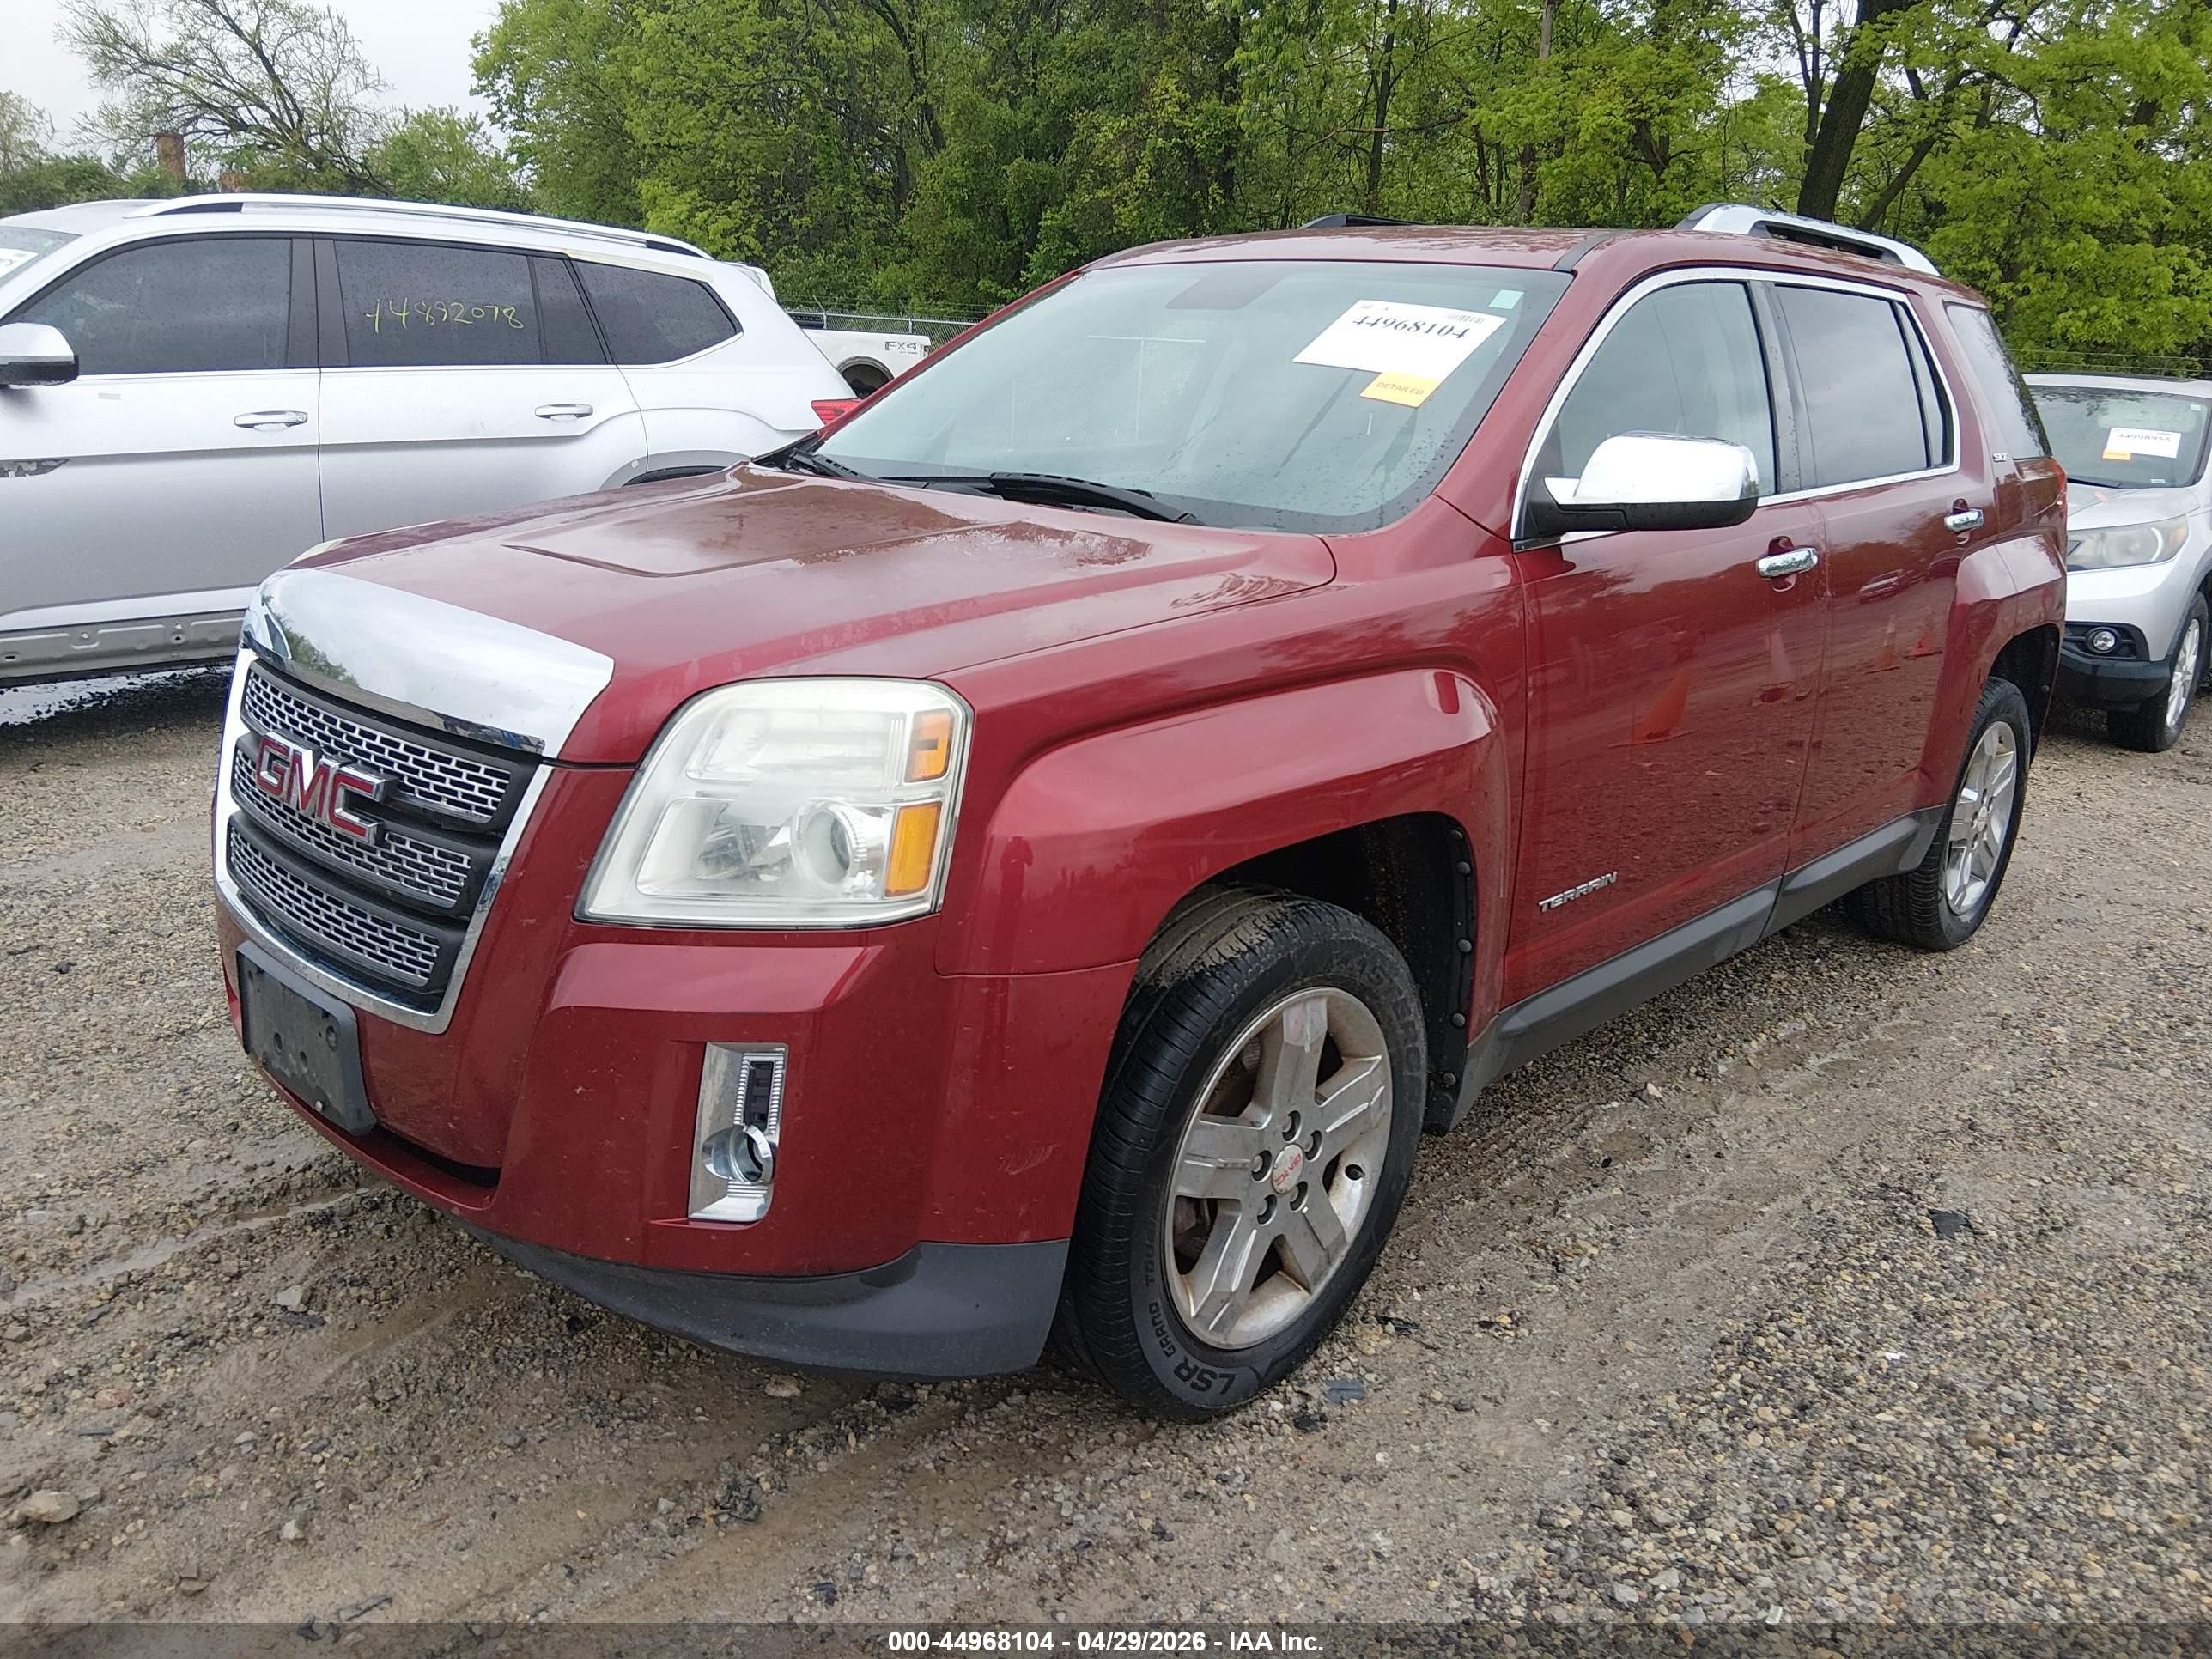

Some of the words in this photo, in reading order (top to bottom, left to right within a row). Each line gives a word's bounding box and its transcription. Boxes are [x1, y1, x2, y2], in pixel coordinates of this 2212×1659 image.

[884, 341, 917, 351] FX4
[1352, 315, 1471, 339] 44968104
[1376, 381, 1425, 395] DETAILED
[255, 732, 386, 845] GMC
[1538, 870, 1618, 913] TERRAIN
[1148, 1301, 1177, 1358] GRAND
[1173, 1356, 1237, 1396] LSR
